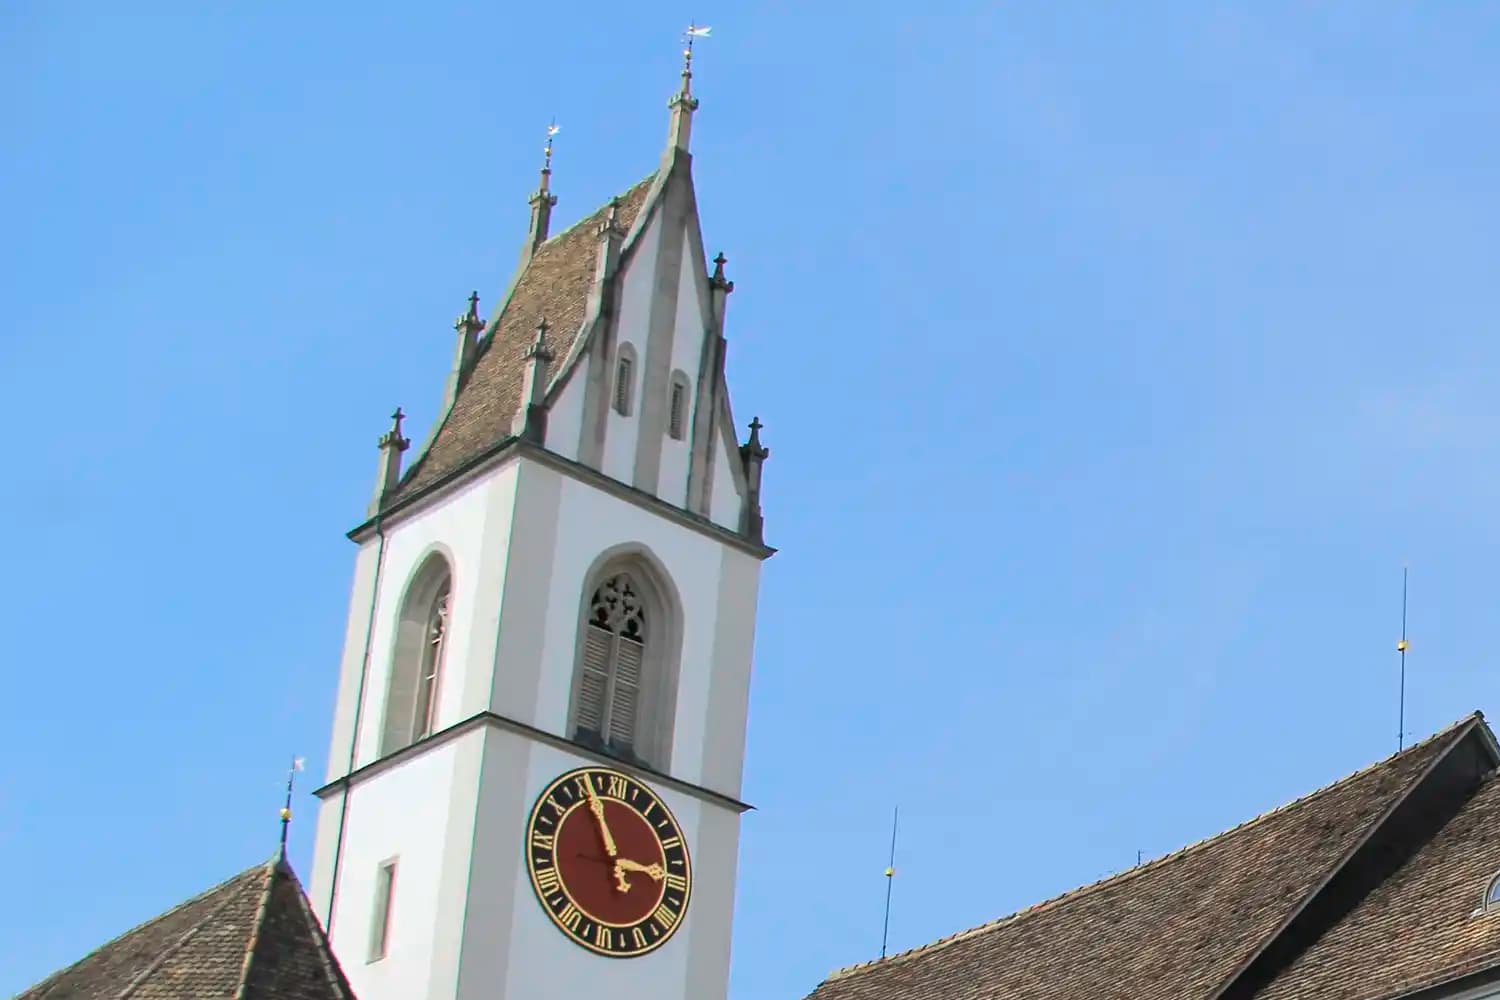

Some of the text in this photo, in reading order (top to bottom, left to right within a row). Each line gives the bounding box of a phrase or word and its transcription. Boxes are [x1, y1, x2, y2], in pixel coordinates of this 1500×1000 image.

[608, 775, 628, 800] XII
[547, 795, 566, 816] X
[644, 801, 657, 816] I
[533, 829, 553, 850] IX
[662, 836, 681, 850] II
[666, 873, 686, 892] III
